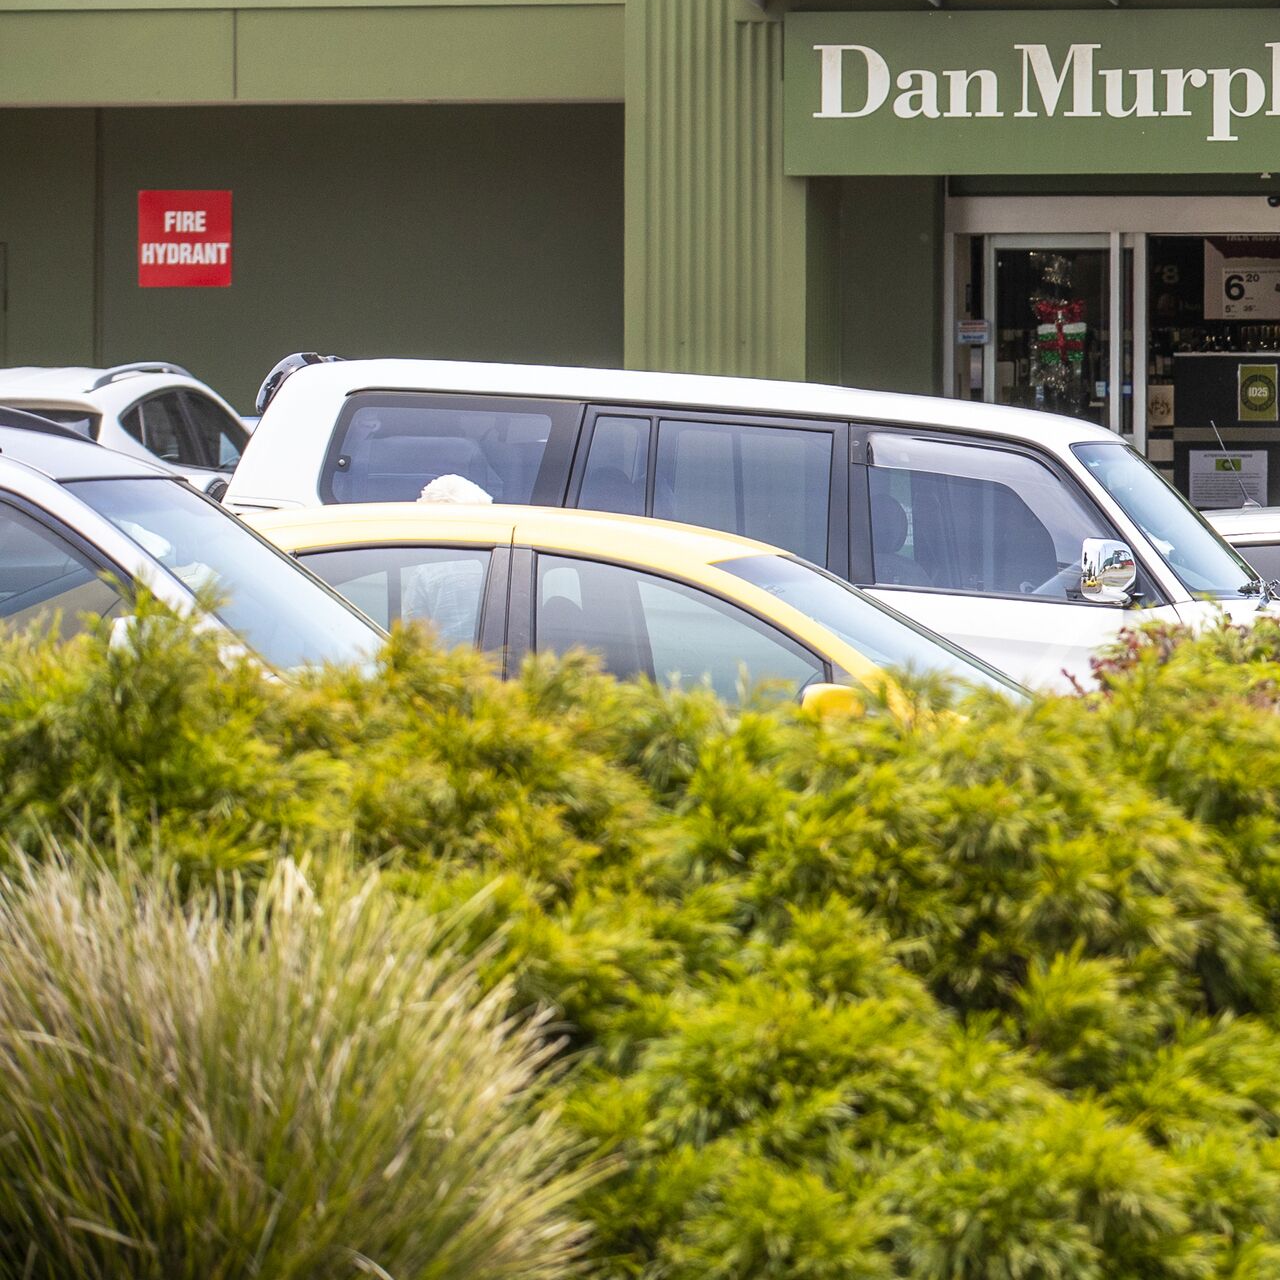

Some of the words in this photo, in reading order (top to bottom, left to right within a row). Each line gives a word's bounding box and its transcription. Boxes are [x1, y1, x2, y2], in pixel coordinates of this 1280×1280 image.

[813, 44, 1006, 119] Dan
[164, 211, 207, 232] FIRE
[141, 243, 230, 265] HYDRANT
[1248, 387, 1268, 397] ID25
